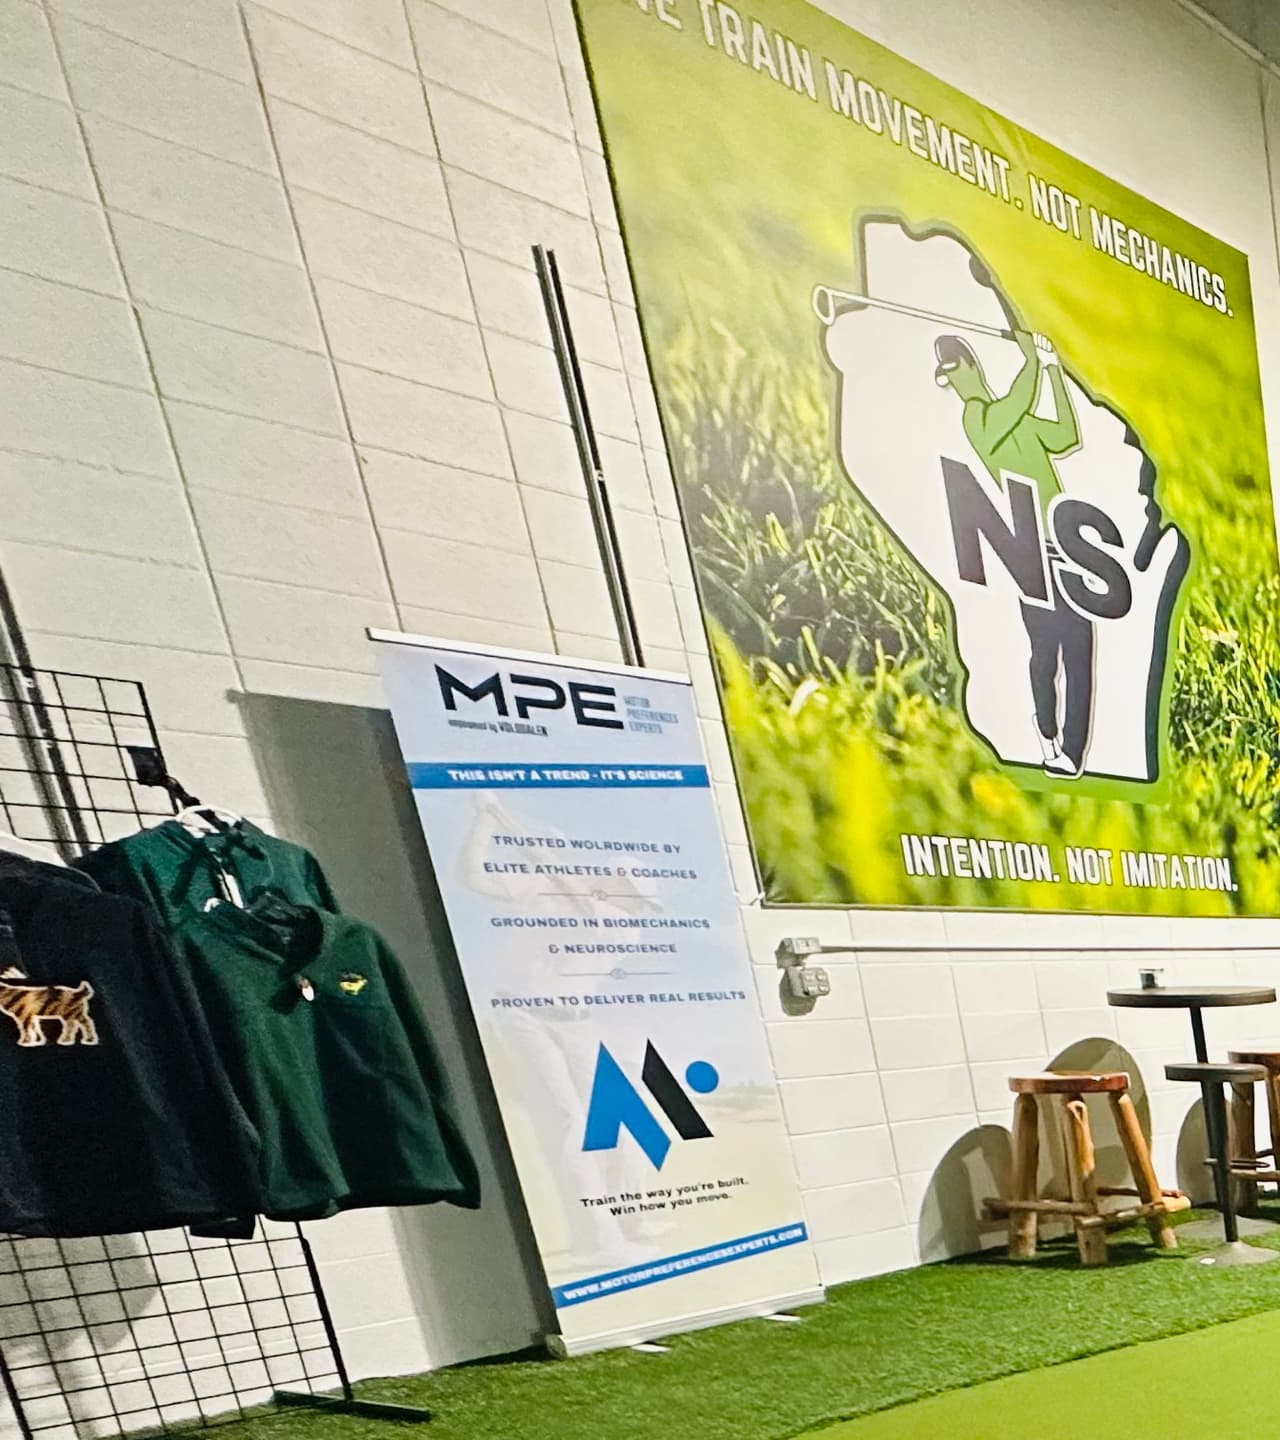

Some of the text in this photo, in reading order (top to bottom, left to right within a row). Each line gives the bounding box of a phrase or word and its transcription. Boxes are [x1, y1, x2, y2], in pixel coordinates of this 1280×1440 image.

[698, 0, 818, 102] TRAIN
[822, 56, 1024, 209] MOVEMENT.
[1028, 173, 1082, 242] NOT
[1089, 207, 1235, 318] MECHANICS.
[940, 456, 1132, 619] NS
[434, 664, 624, 729] MPE
[448, 769, 485, 782] THIS
[488, 769, 526, 782] ISN'T
[531, 770, 542, 781] A
[543, 769, 590, 782] TREND
[600, 769, 626, 782] IT'S
[628, 769, 684, 782] SCIENCE
[491, 835, 681, 854] TRUSTED WOLRDWIDE BY
[483, 862, 697, 880] ELITE ATHLETES & COACHES
[900, 833, 1239, 893] INTENTION. NOT IMITATION.
[491, 917, 711, 929] GROUNDED IN BIOMECHANICS
[548, 943, 677, 954] & NEUROSCIENCE
[491, 991, 746, 1008] PROVEN TO DELIVER REAL RESULTS
[580, 1177, 749, 1208] Train the way you're built.
[610, 1192, 733, 1217] Win how you move.
